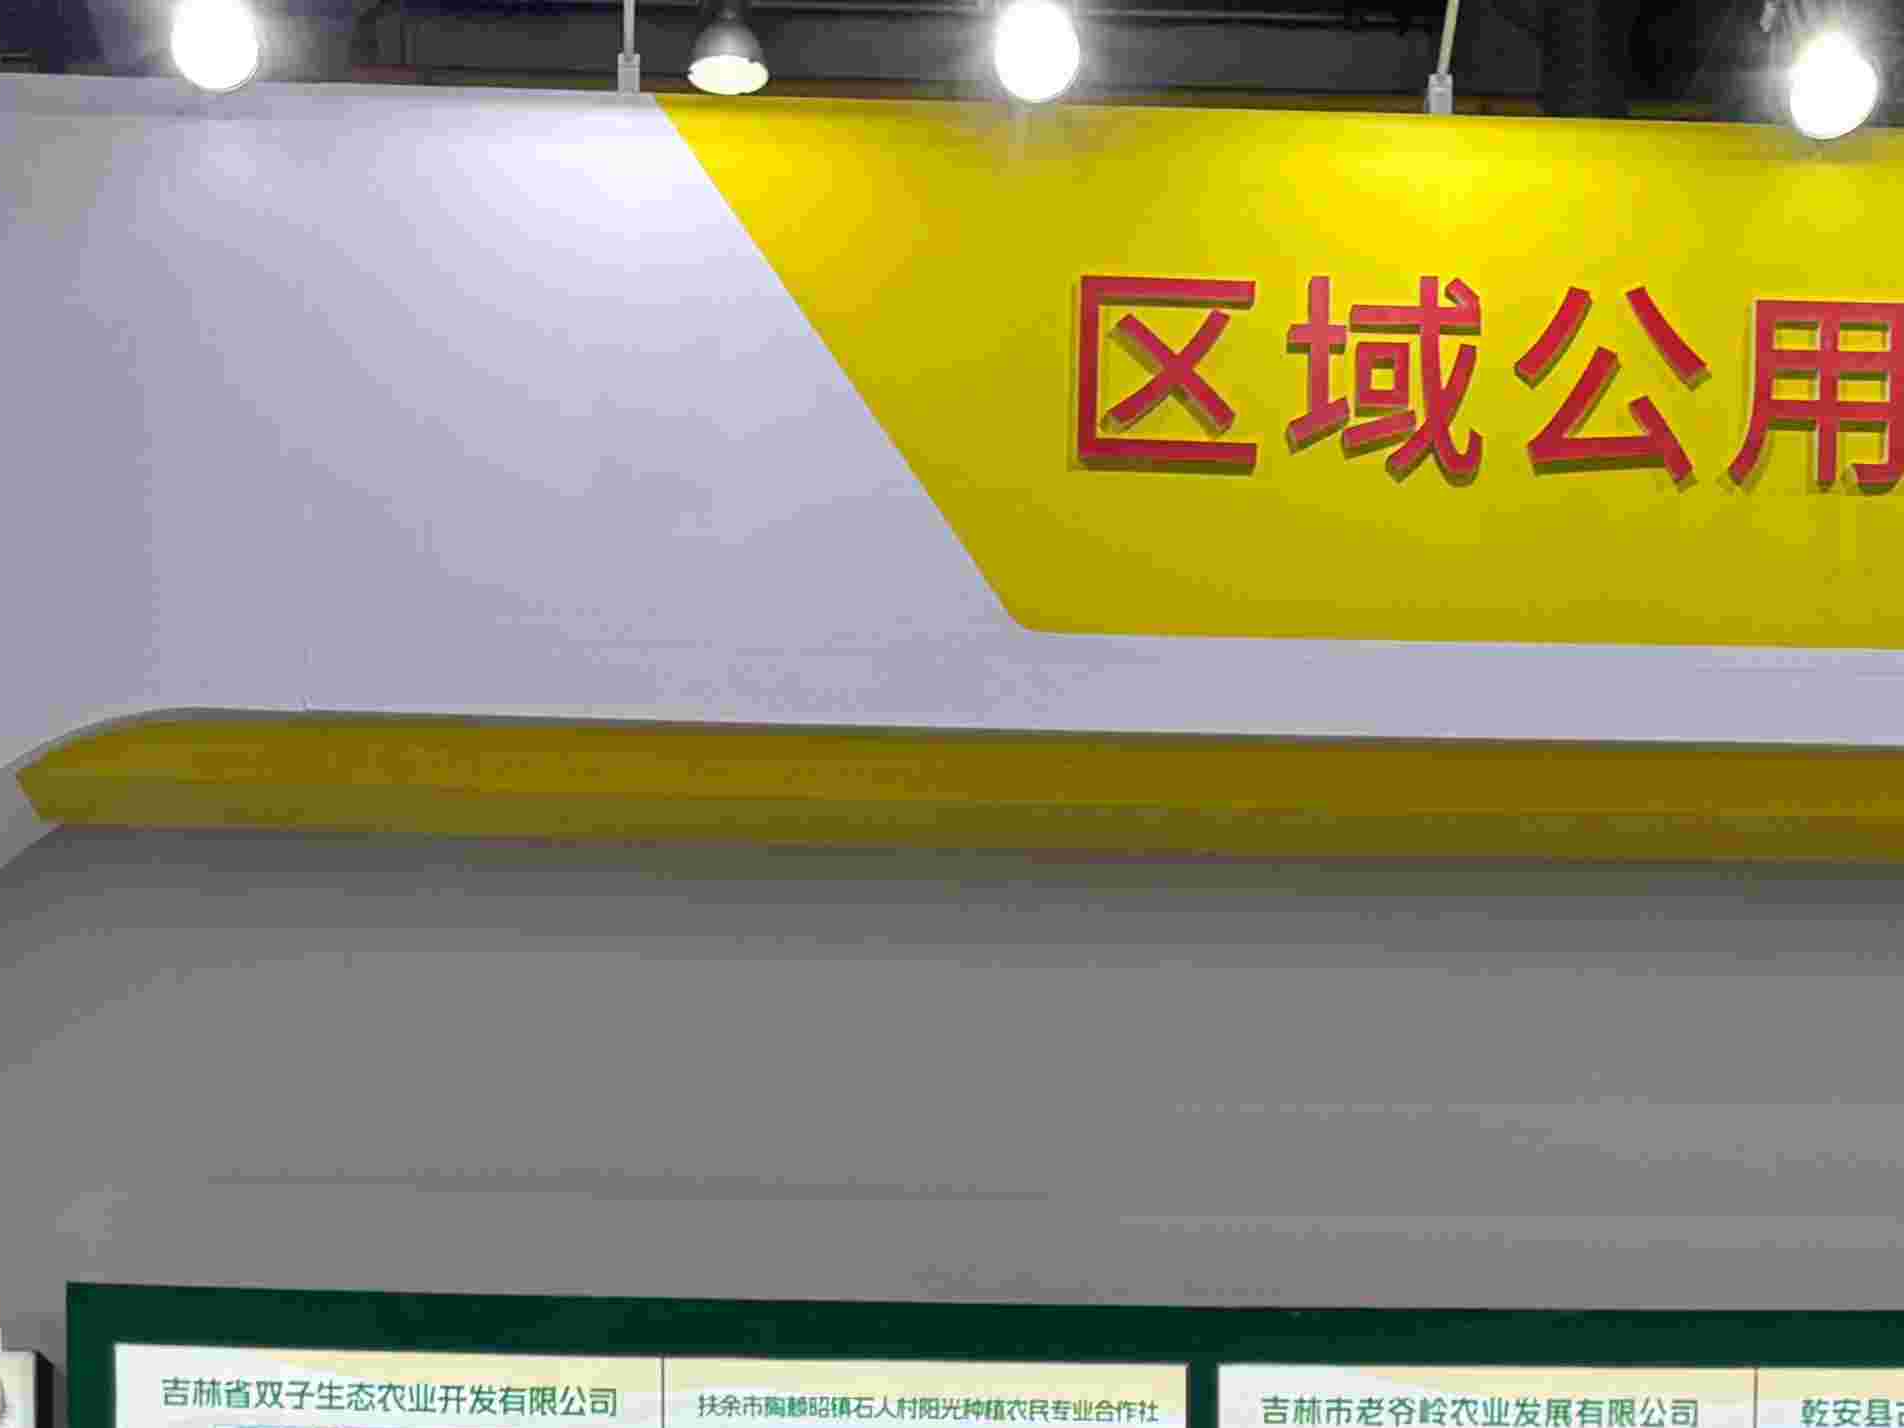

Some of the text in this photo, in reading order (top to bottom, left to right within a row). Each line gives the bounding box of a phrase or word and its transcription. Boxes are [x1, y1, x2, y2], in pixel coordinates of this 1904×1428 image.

[161, 1376, 618, 1417] 吉林省双子生态农业开发有限公司
